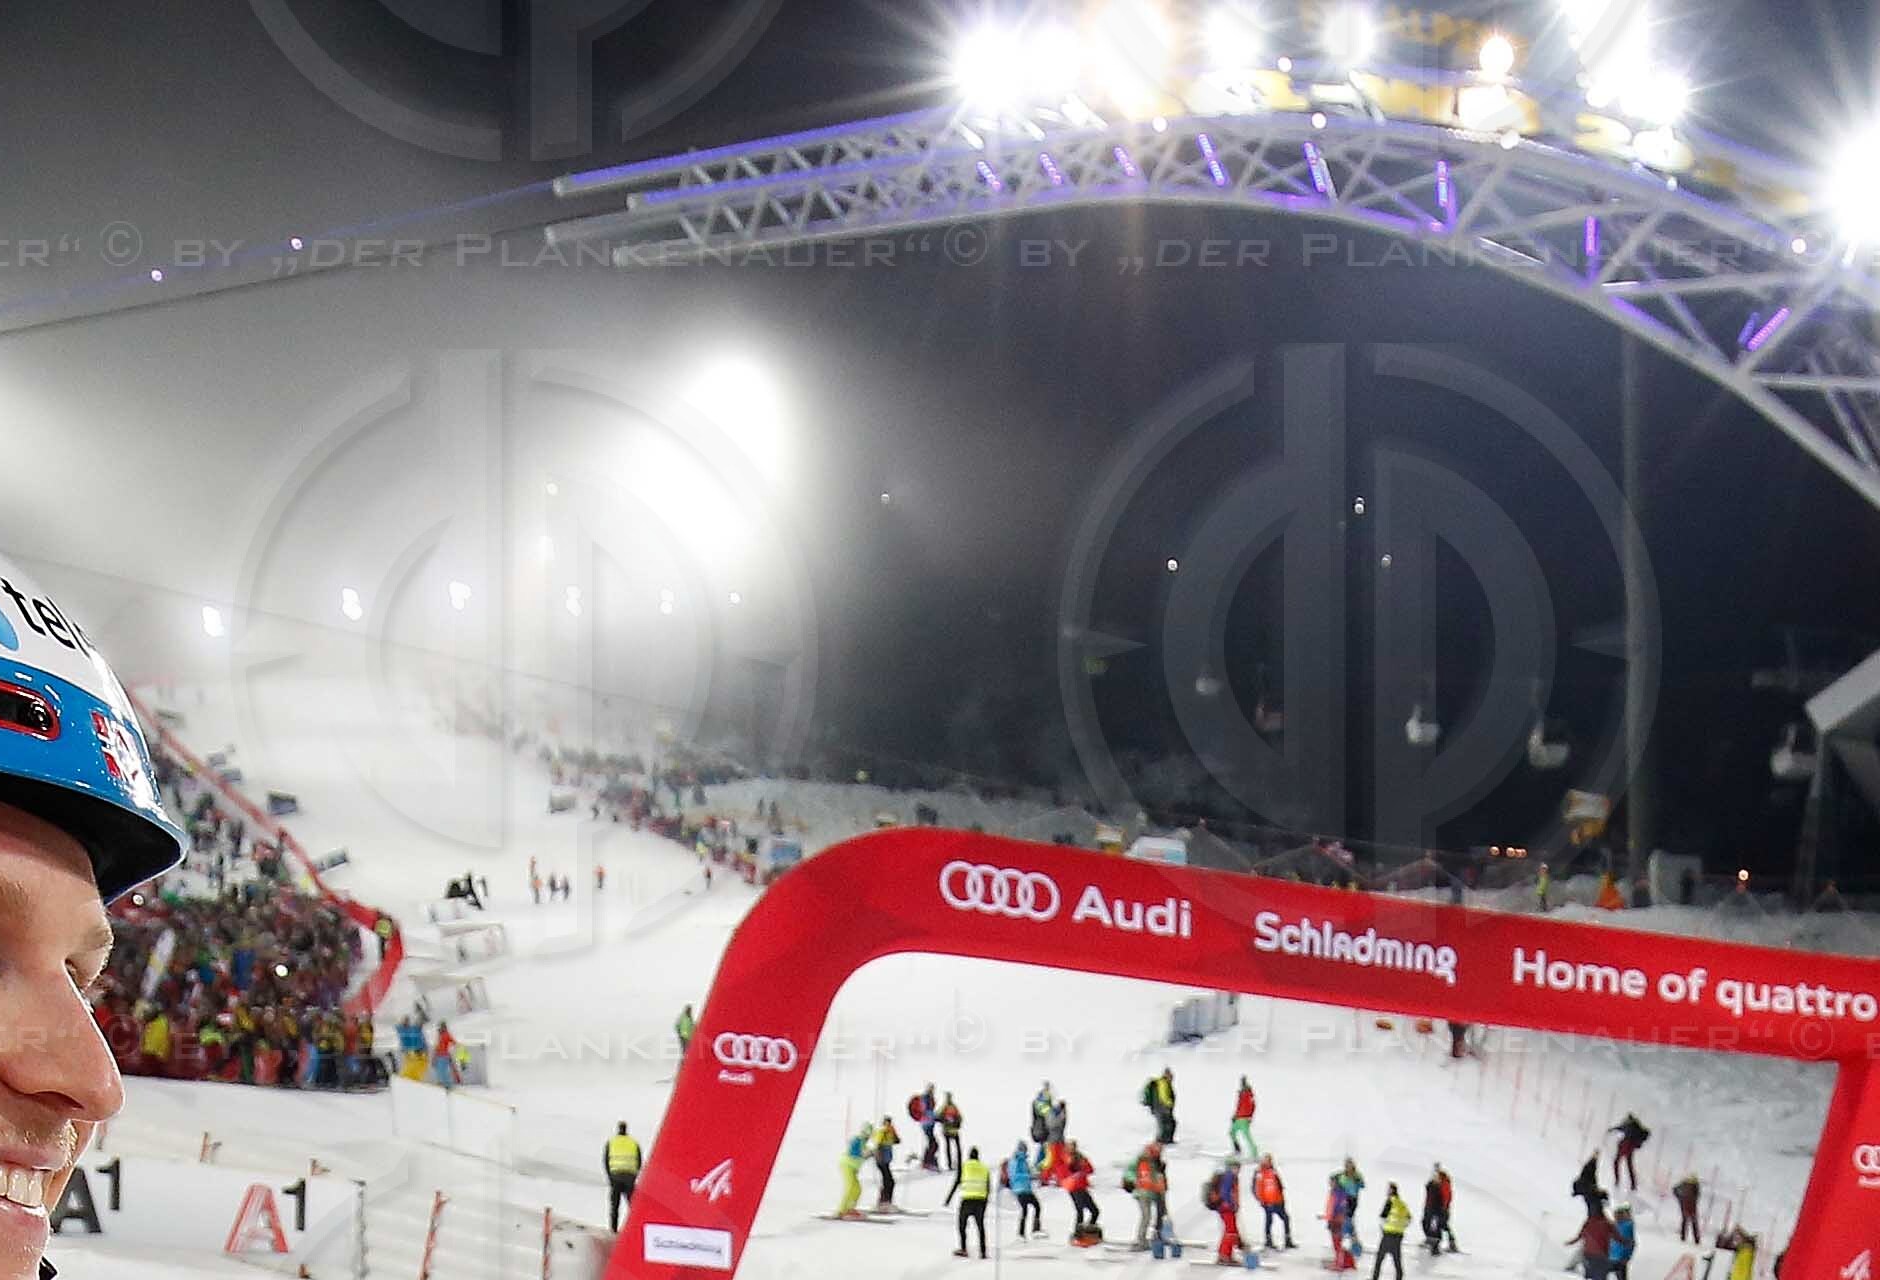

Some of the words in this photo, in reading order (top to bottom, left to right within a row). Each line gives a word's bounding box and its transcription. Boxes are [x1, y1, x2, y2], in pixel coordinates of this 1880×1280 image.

[1073, 885, 1193, 939] Audi
[1512, 948, 1646, 1000] Home
[1660, 966, 1708, 1004] of
[1717, 977, 1878, 1022] quattro
